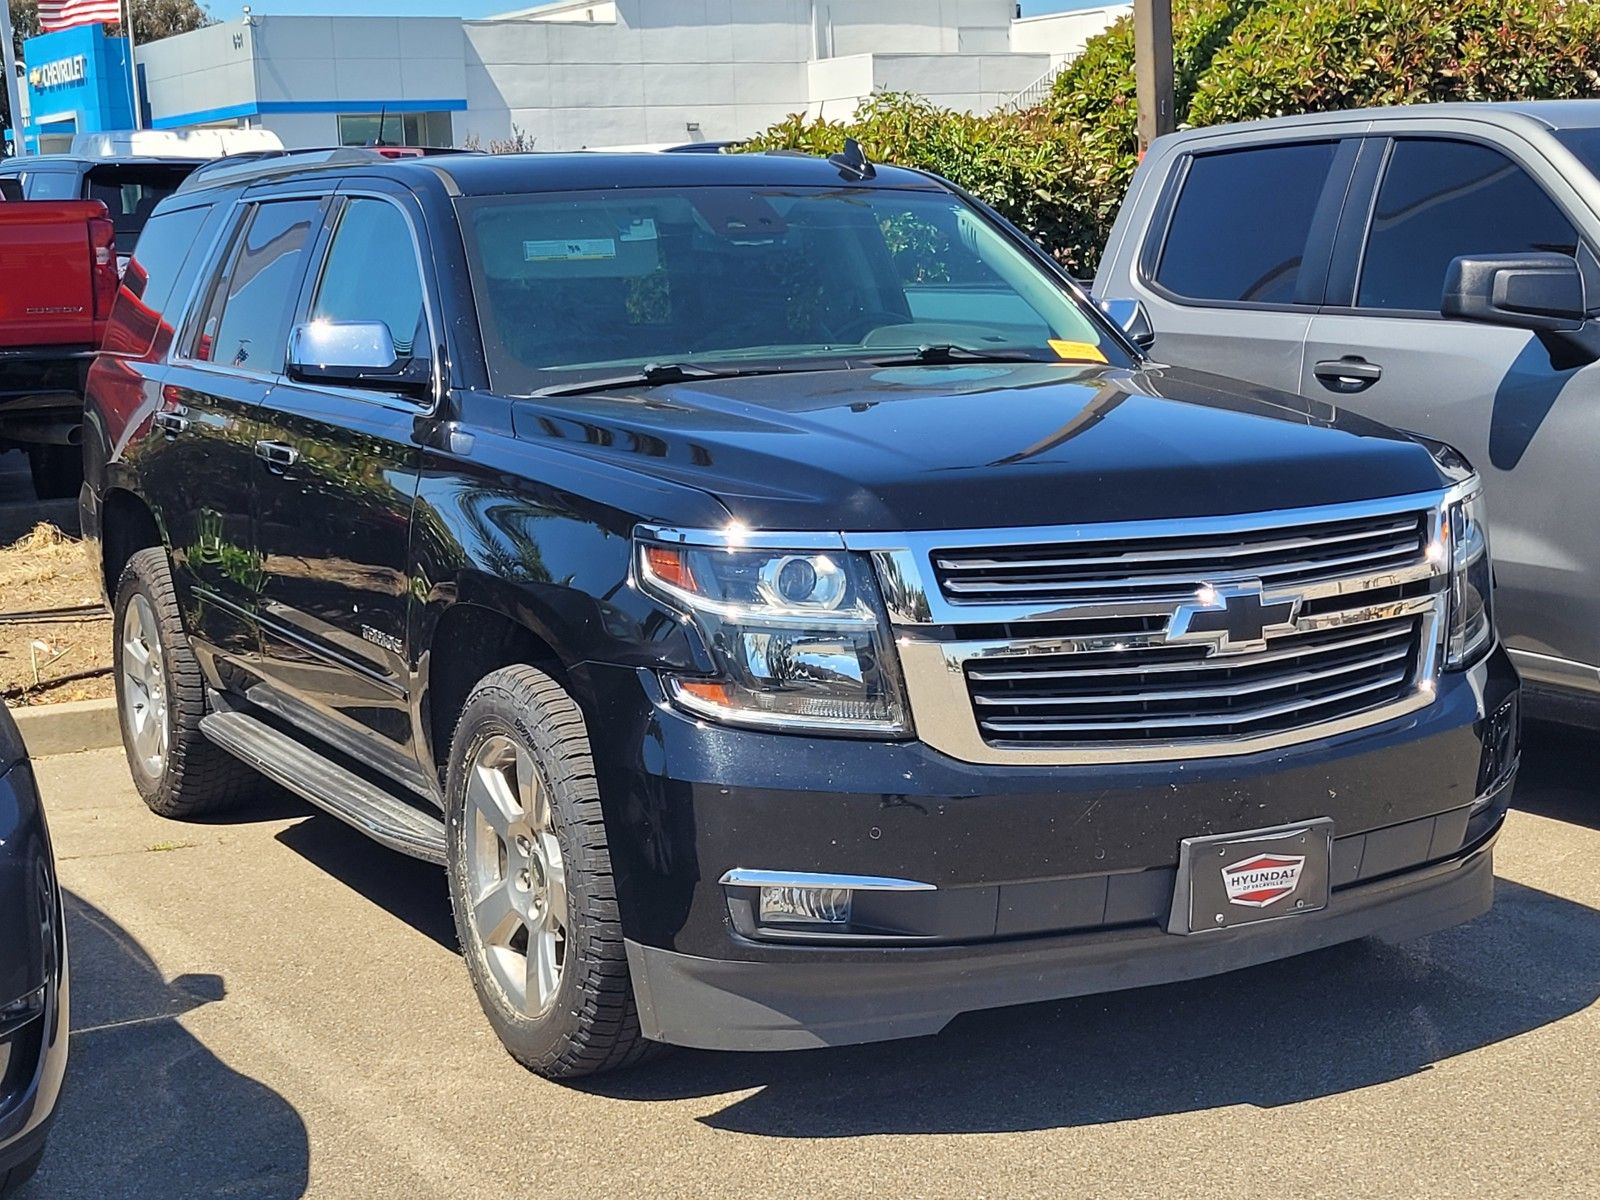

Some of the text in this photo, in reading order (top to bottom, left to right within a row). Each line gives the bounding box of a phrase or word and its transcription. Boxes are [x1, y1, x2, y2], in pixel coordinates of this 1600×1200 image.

[42, 54, 84, 86] CHEVROLET
[26, 306, 83, 314] CUSTOM
[361, 624, 403, 654] TAHOE
[1231, 868, 1296, 887] HYUNDAI
[1251, 880, 1284, 889] VACAVILLE
